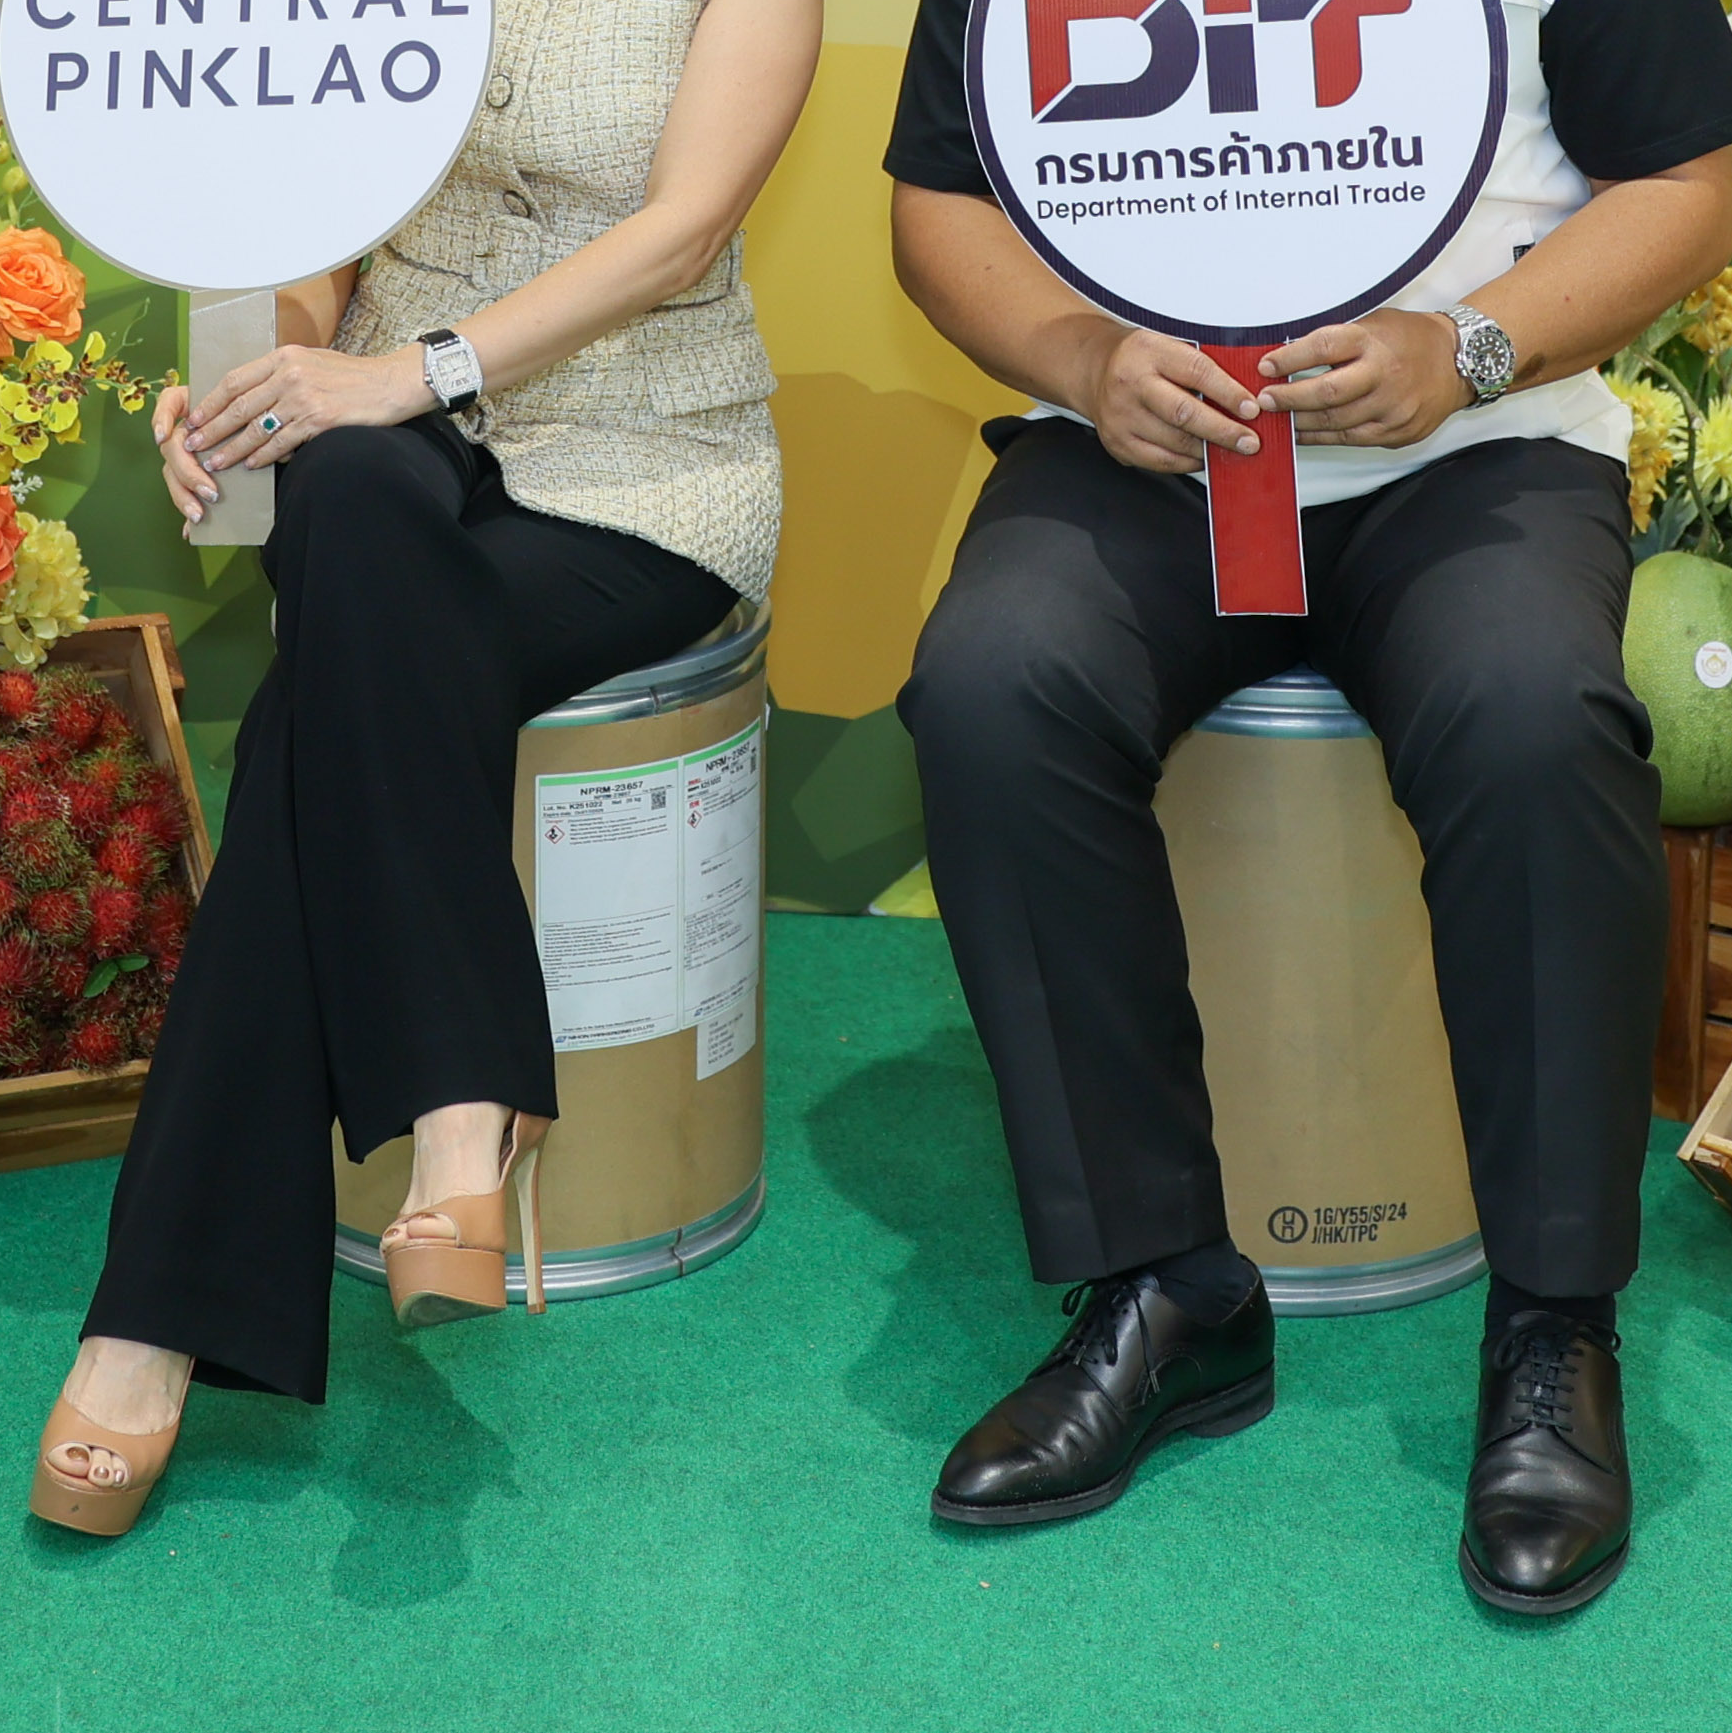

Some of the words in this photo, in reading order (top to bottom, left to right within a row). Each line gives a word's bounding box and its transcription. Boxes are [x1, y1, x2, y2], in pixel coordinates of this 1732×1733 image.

[46, 40, 442, 111] PINKLAO
[1035, 125, 1424, 185] กรมการค้าภายใน
[1037, 193, 1196, 224] Department
[1203, 190, 1228, 213] of
[1235, 185, 1339, 209] Internal
[1347, 182, 1426, 205] Trade
[580, 781, 644, 796] NPRM-23657
[1314, 1202, 1407, 1225] 1G/Y55/S/24
[1312, 1224, 1378, 1244] J/HK/TPC
